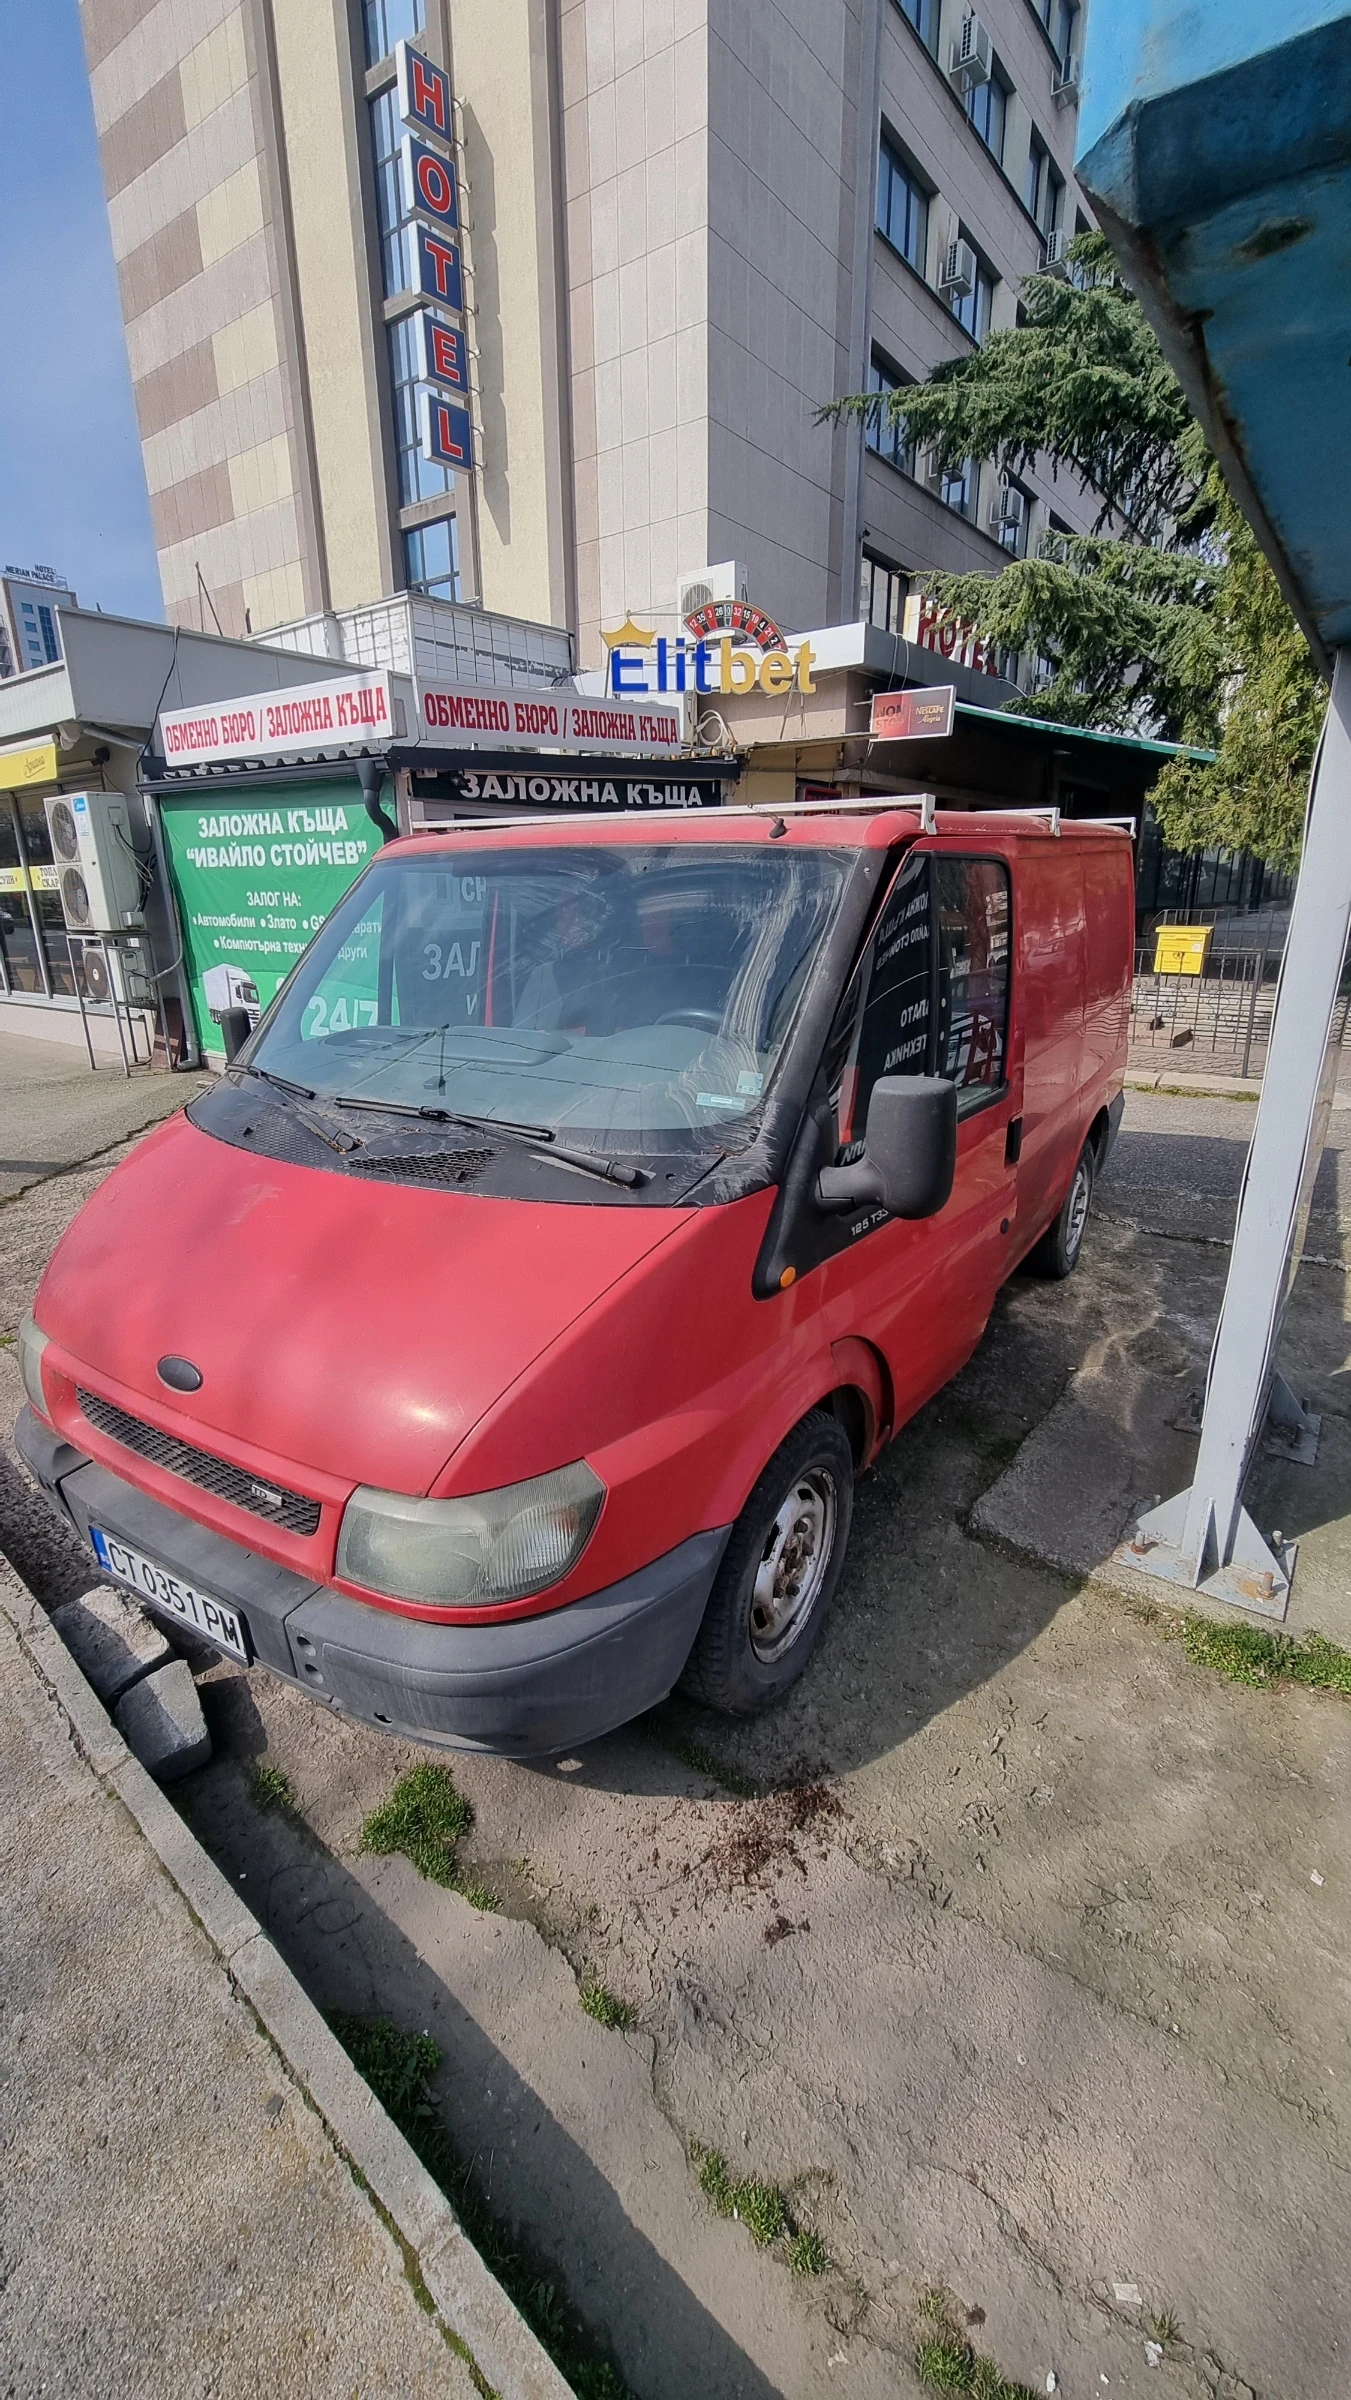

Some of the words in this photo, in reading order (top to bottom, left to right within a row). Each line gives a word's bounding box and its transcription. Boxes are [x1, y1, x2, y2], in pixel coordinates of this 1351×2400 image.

[411, 56, 463, 460] HOTEL
[31, 571, 54, 582] PALACE
[690, 619, 698, 629] 12
[696, 612, 706, 623] 35
[714, 607, 724, 617] 26
[733, 607, 742, 617] 32
[743, 609, 751, 620] 15
[751, 613, 760, 624] 19
[764, 627, 774, 638] 21
[611, 637, 817, 696] Elitbet
[165, 717, 219, 753] ОБМЕННО
[220, 710, 256, 744] БЮРО
[266, 697, 334, 738] ЗАЛОЖНА
[337, 687, 387, 727] КЪЩА
[424, 692, 510, 732] ОБМЕННО
[515, 702, 559, 736] БЮРО
[572, 708, 637, 742] ЗАЛОЖНА
[639, 715, 678, 746] КЪЩА
[460, 772, 620, 804] ЗАЛОЖНА
[627, 783, 703, 809] КЪЩА
[198, 812, 284, 838] ЗАЛОЖНА
[288, 806, 348, 835] КЪЩА
[41, 878, 59, 888] СКАР
[246, 891, 280, 907] ЗАЛОГ
[283, 891, 302, 907] НА:
[197, 912, 256, 928] Автомобили
[267, 913, 296, 930] Злато
[221, 936, 281, 955] Компютърна
[283, 941, 308, 954] техн
[308, 995, 378, 1036] 24/7
[142, 1563, 201, 1624] 0351
